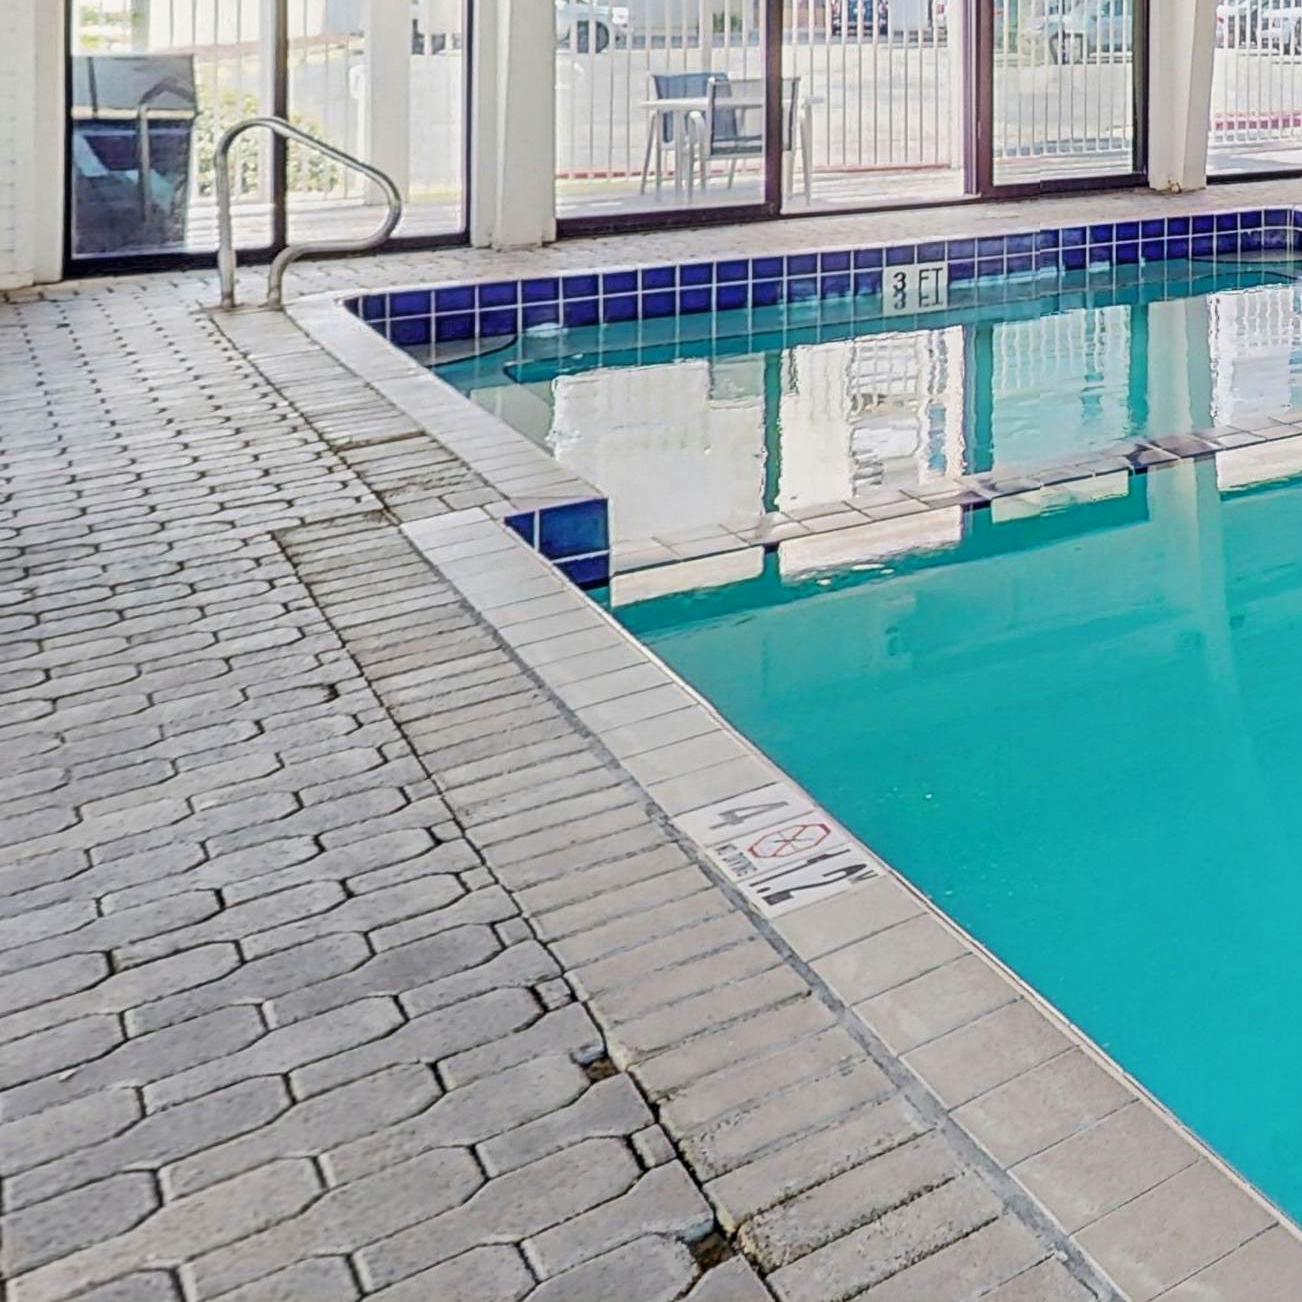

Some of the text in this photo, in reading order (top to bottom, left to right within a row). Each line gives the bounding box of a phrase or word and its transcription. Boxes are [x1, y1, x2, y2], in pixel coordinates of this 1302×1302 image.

[893, 267, 944, 293] 3 FT
[709, 801, 790, 830] 4
